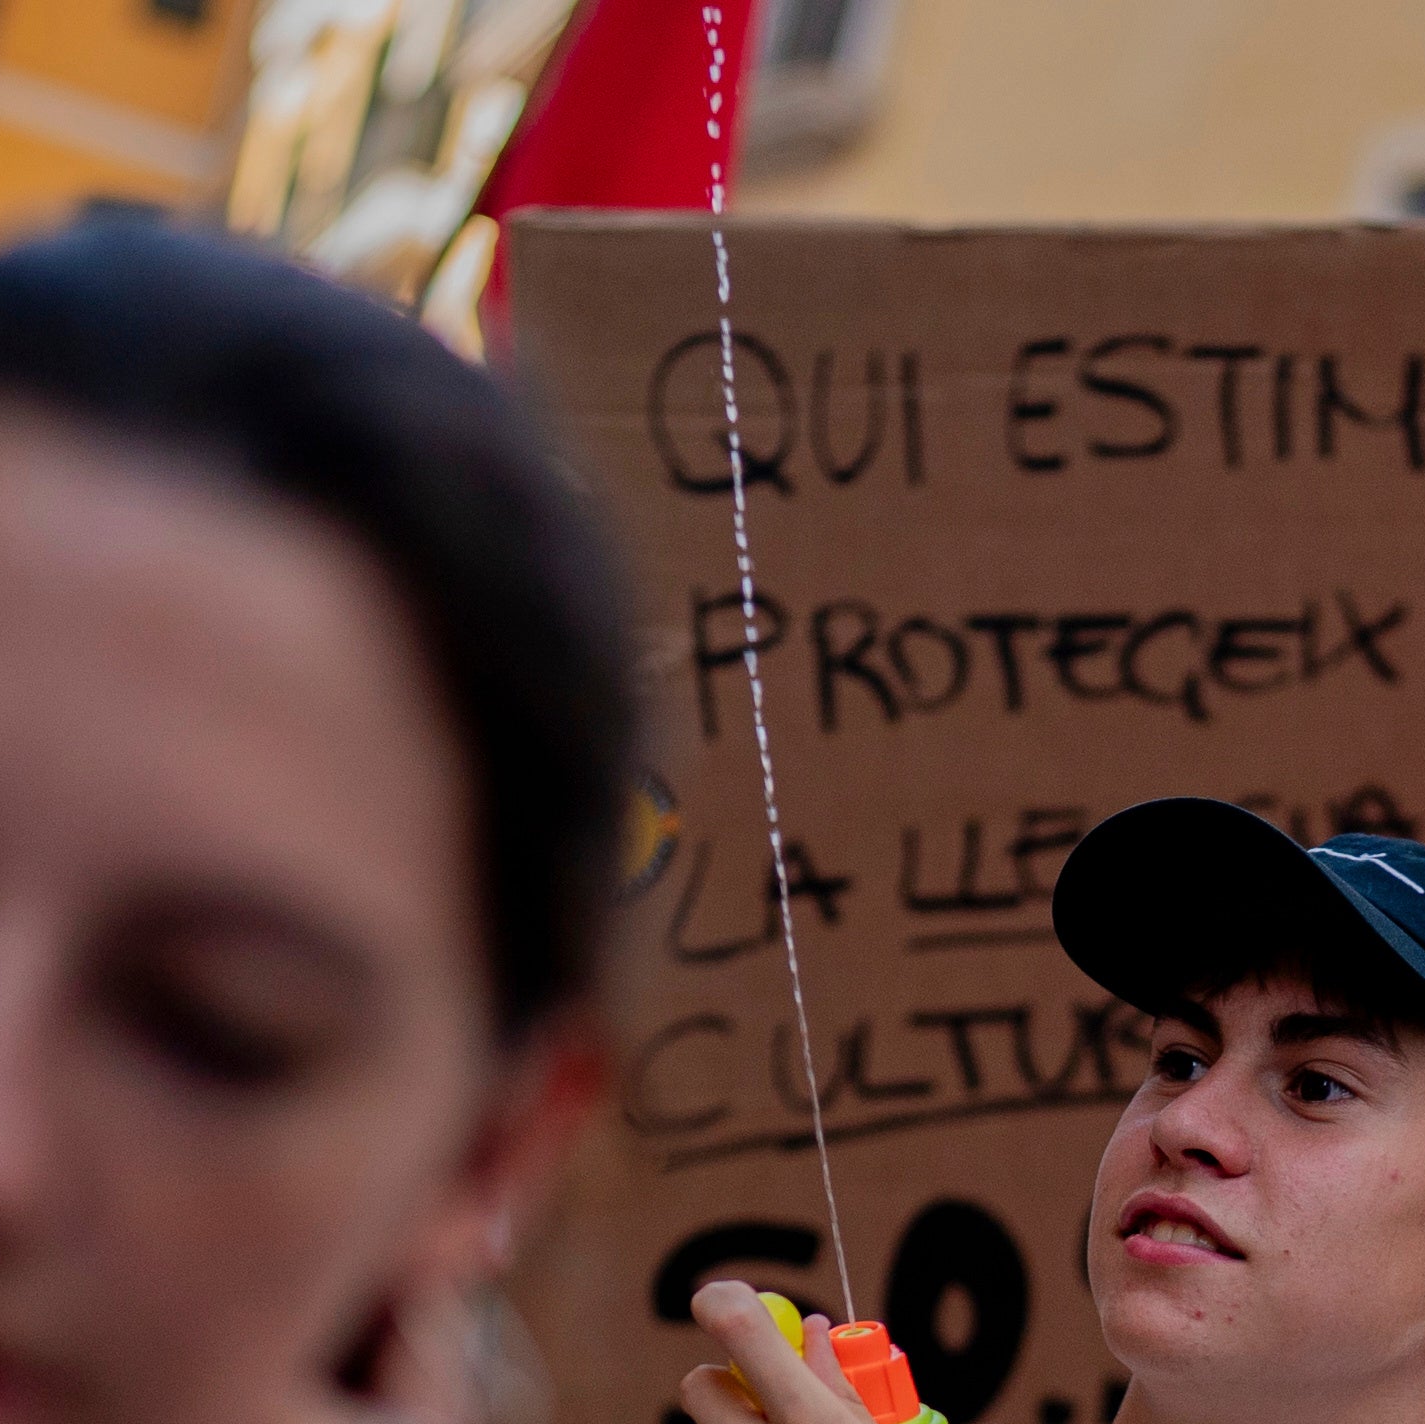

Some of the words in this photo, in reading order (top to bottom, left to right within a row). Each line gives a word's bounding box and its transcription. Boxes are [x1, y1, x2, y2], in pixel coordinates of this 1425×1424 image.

[648, 330, 924, 497] QUI
[686, 585, 1410, 743] PROTEGEIX
[666, 840, 852, 968] LA
[624, 1002, 1156, 1137] CULTUR
